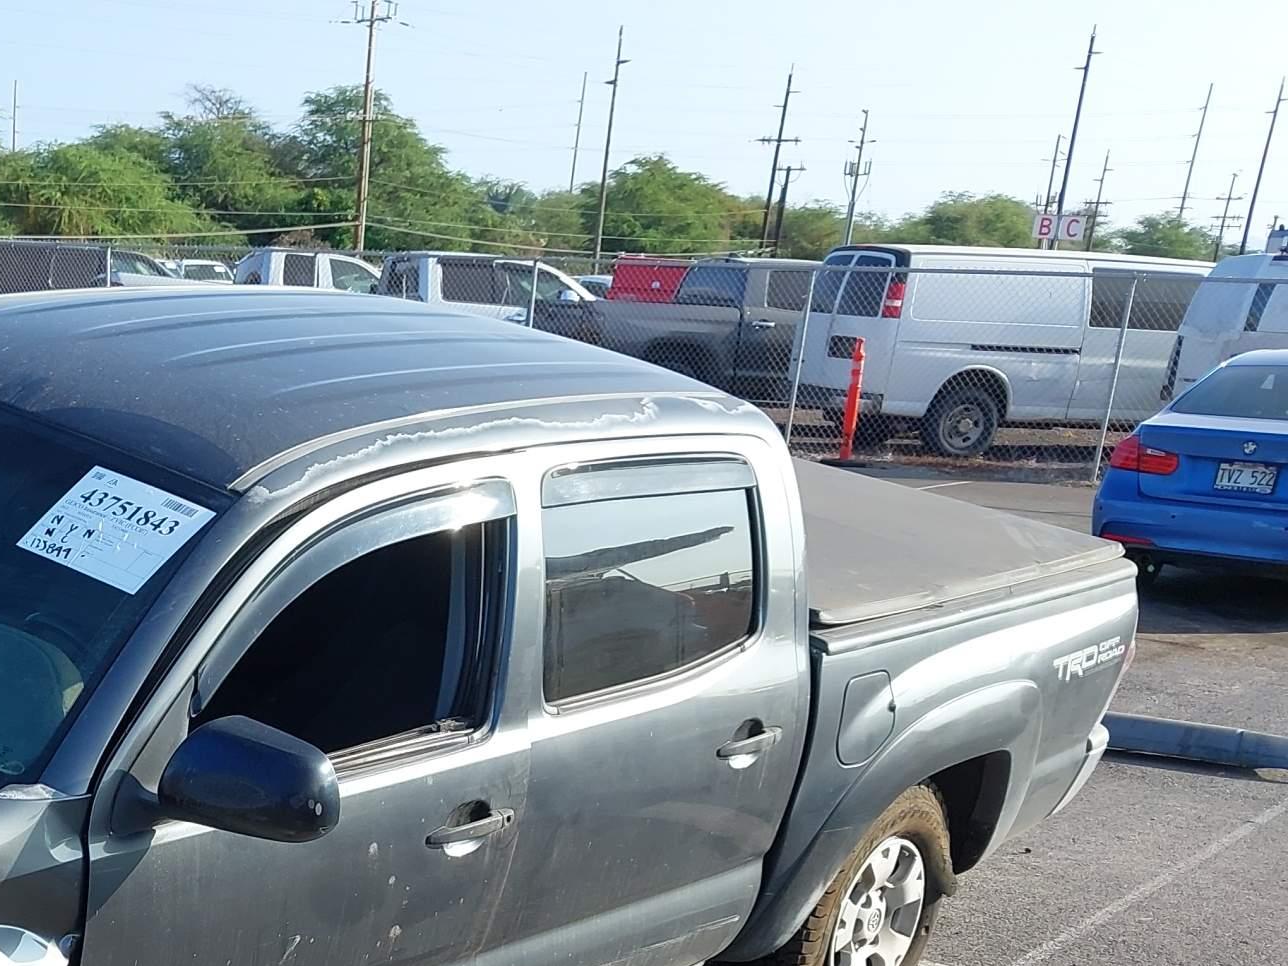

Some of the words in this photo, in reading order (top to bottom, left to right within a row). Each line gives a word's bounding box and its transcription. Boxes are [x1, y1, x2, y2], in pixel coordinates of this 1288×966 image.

[1038, 217, 1053, 236] B
[1066, 218, 1080, 238] C
[1219, 468, 1244, 485] TVZ
[1249, 470, 1275, 487] 522
[79, 489, 180, 536] 43751843
[50, 514, 65, 525] N
[82, 529, 96, 539] N
[1053, 644, 1099, 682] TRD
